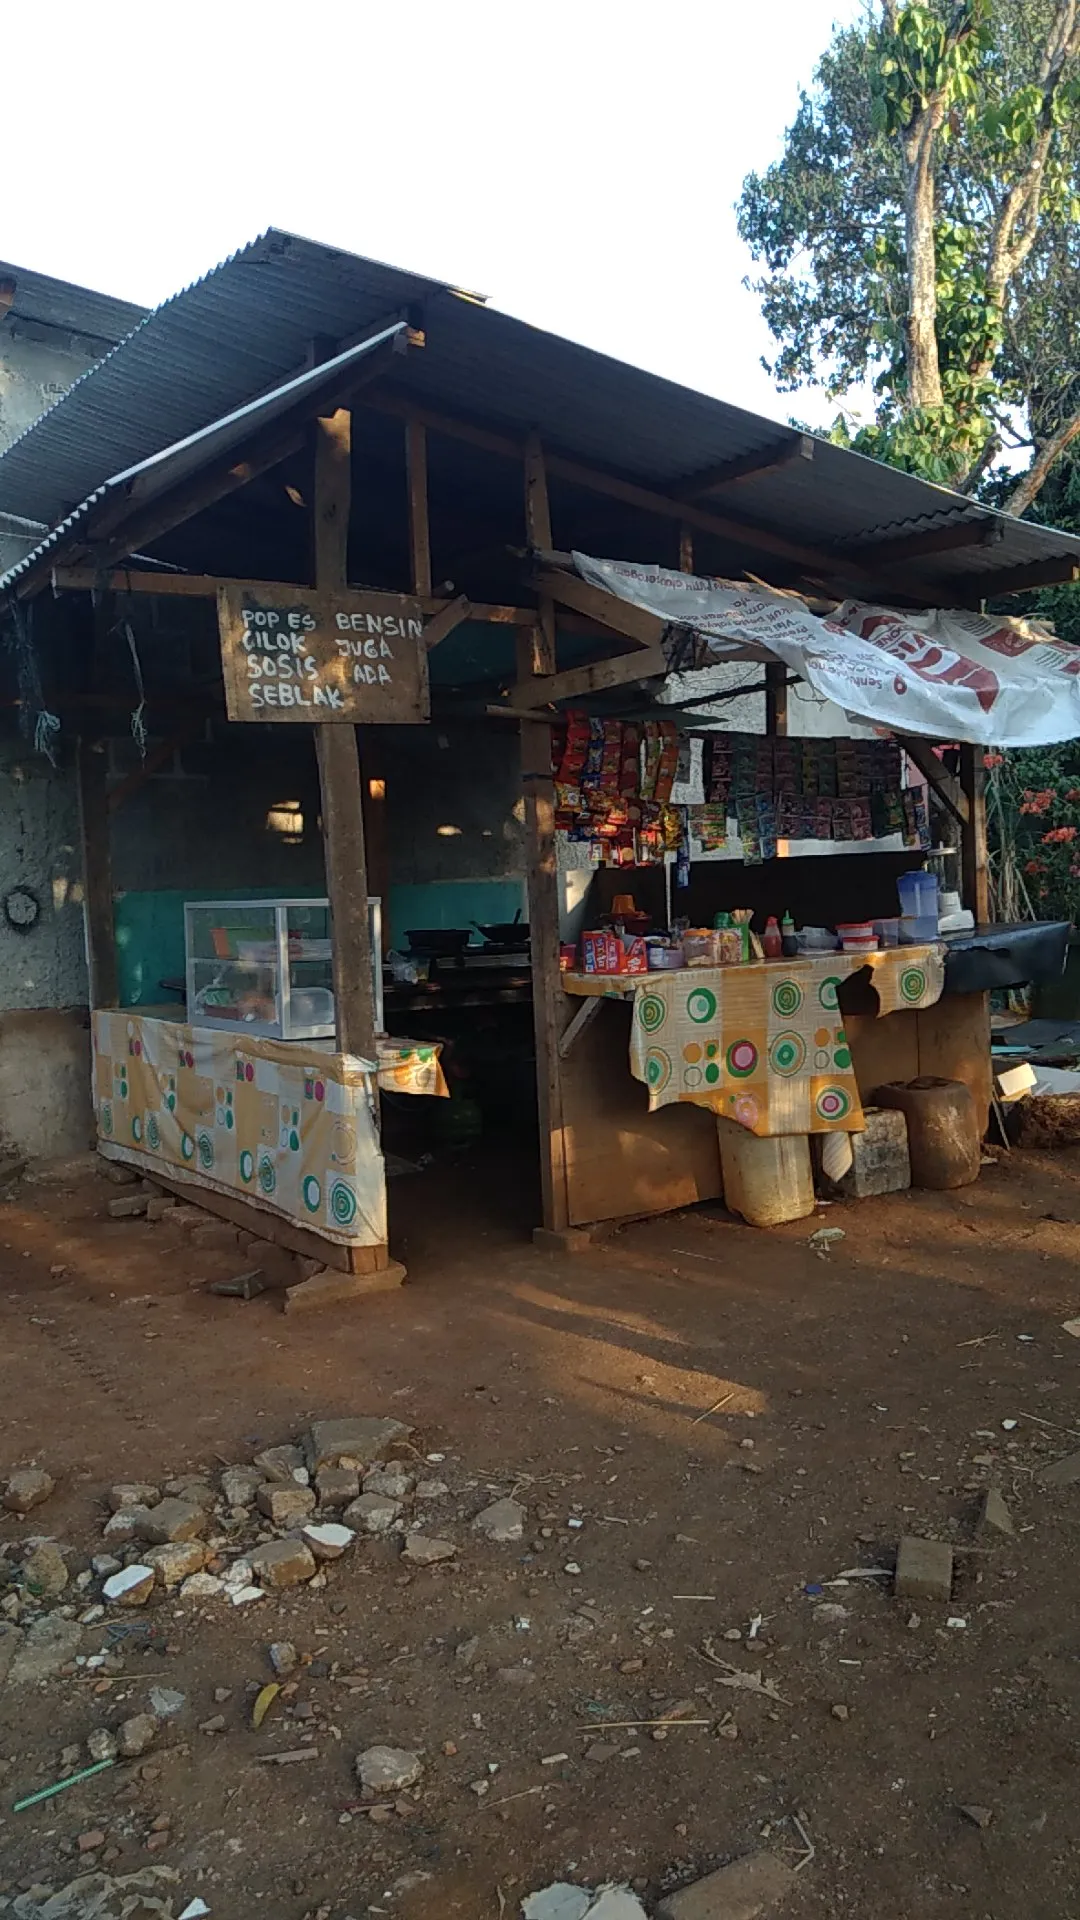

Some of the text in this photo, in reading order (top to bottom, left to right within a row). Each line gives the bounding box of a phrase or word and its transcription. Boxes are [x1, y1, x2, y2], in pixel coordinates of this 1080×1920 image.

[241, 609, 316, 632] POP ES
[335, 612, 424, 640] BENSIN
[242, 629, 308, 654] CILOK
[334, 636, 395, 660] JUGA
[247, 653, 320, 681] SOSIS
[353, 664, 393, 686] ADA
[247, 681, 344, 710] SEBLAK
